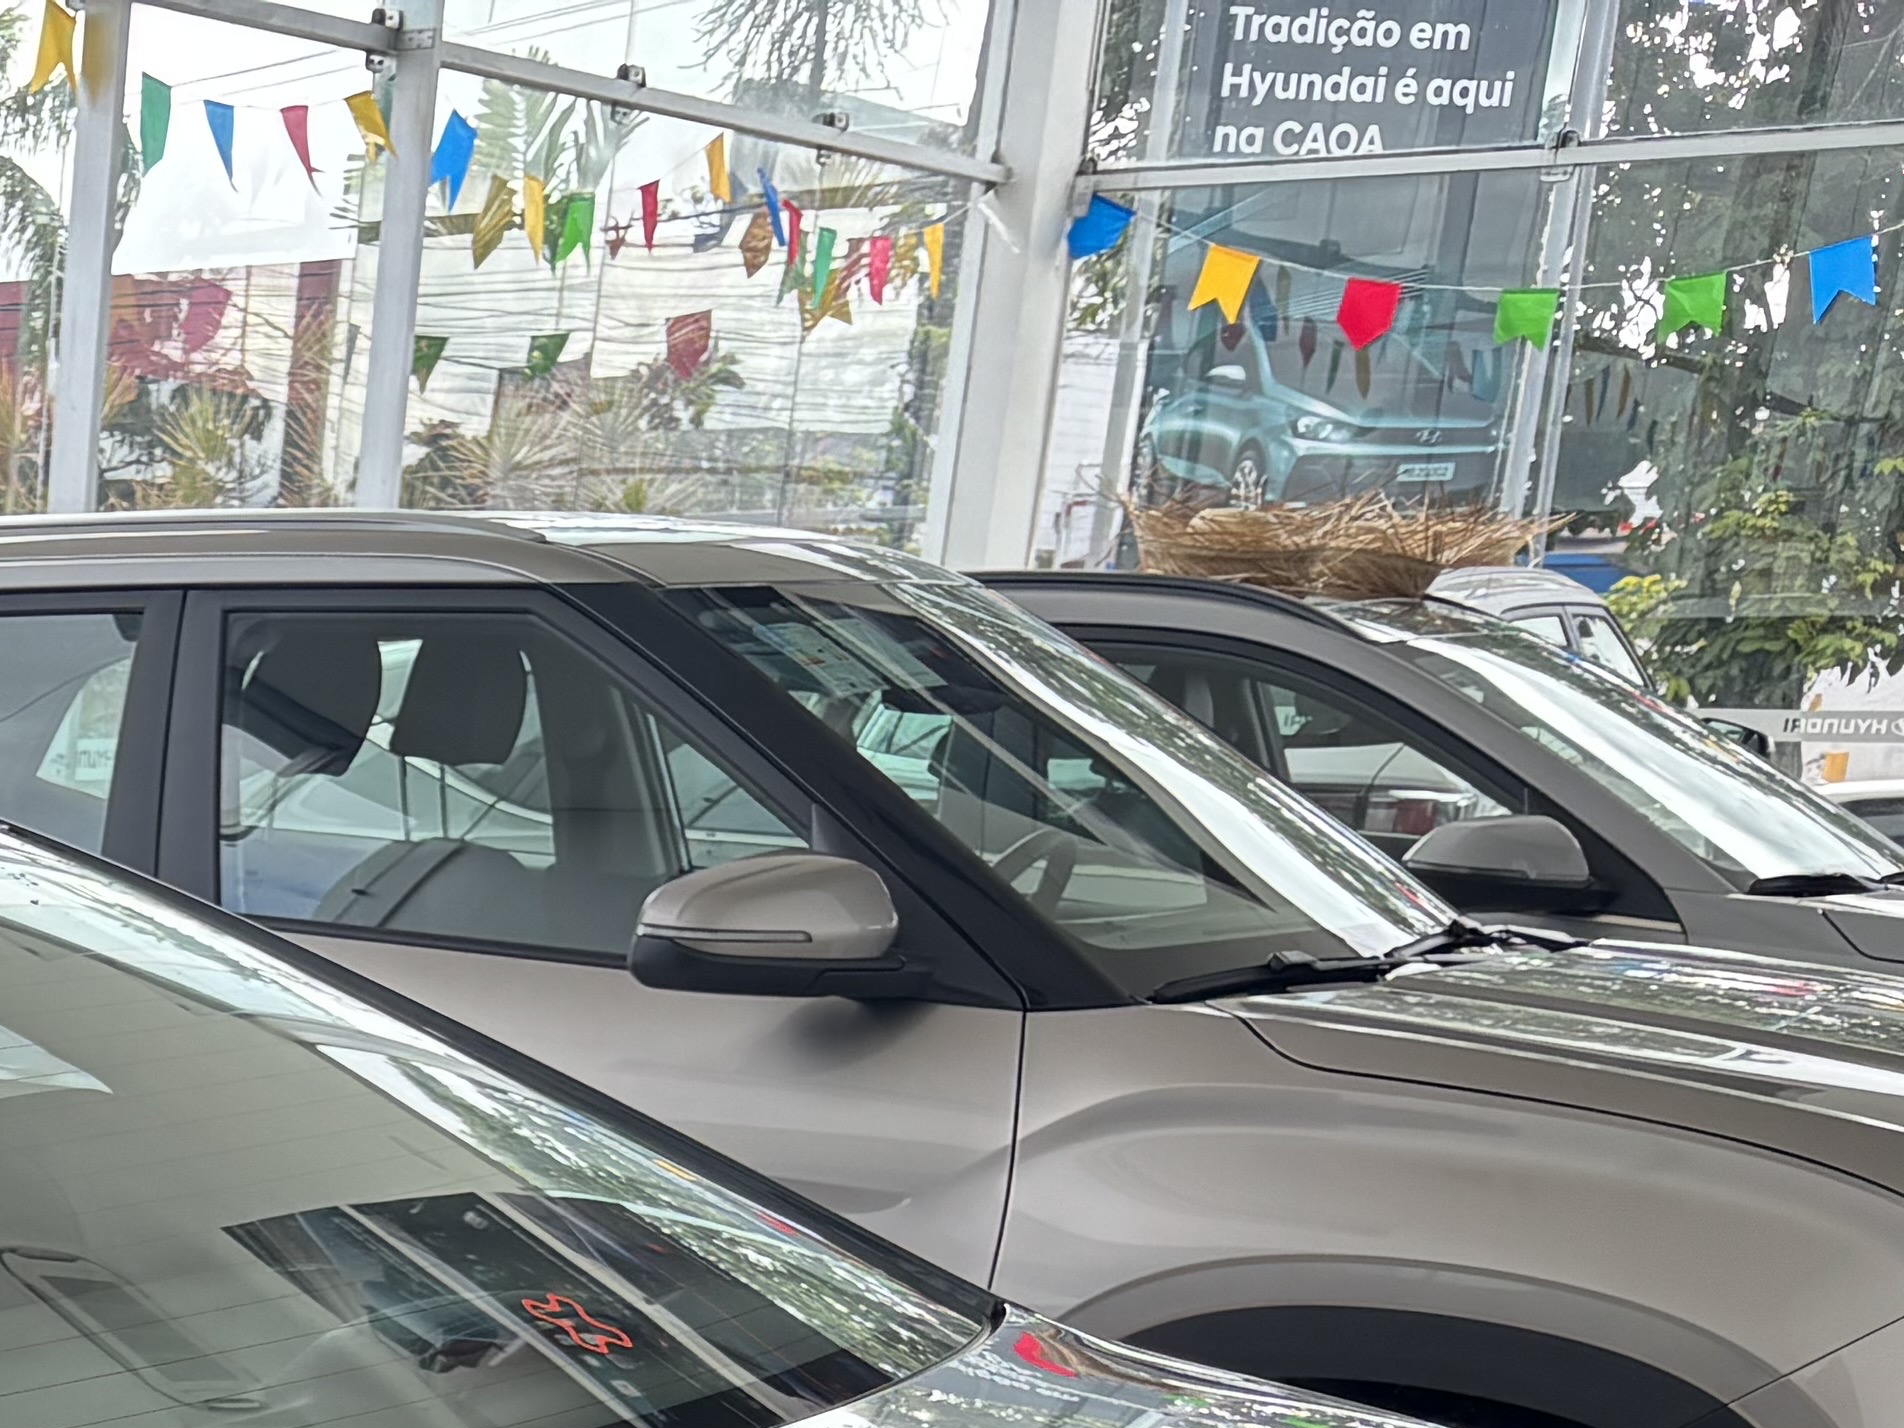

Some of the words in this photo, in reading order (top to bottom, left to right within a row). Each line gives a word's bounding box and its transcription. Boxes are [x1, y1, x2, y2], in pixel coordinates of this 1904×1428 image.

[1229, 6, 1401, 54] Tradição
[1409, 21, 1471, 51] em
[1220, 62, 1389, 106] Hyundai
[1394, 67, 1419, 105] é
[1425, 70, 1516, 115] aqui
[1212, 124, 1265, 154] na
[1272, 120, 1384, 156] CAOA
